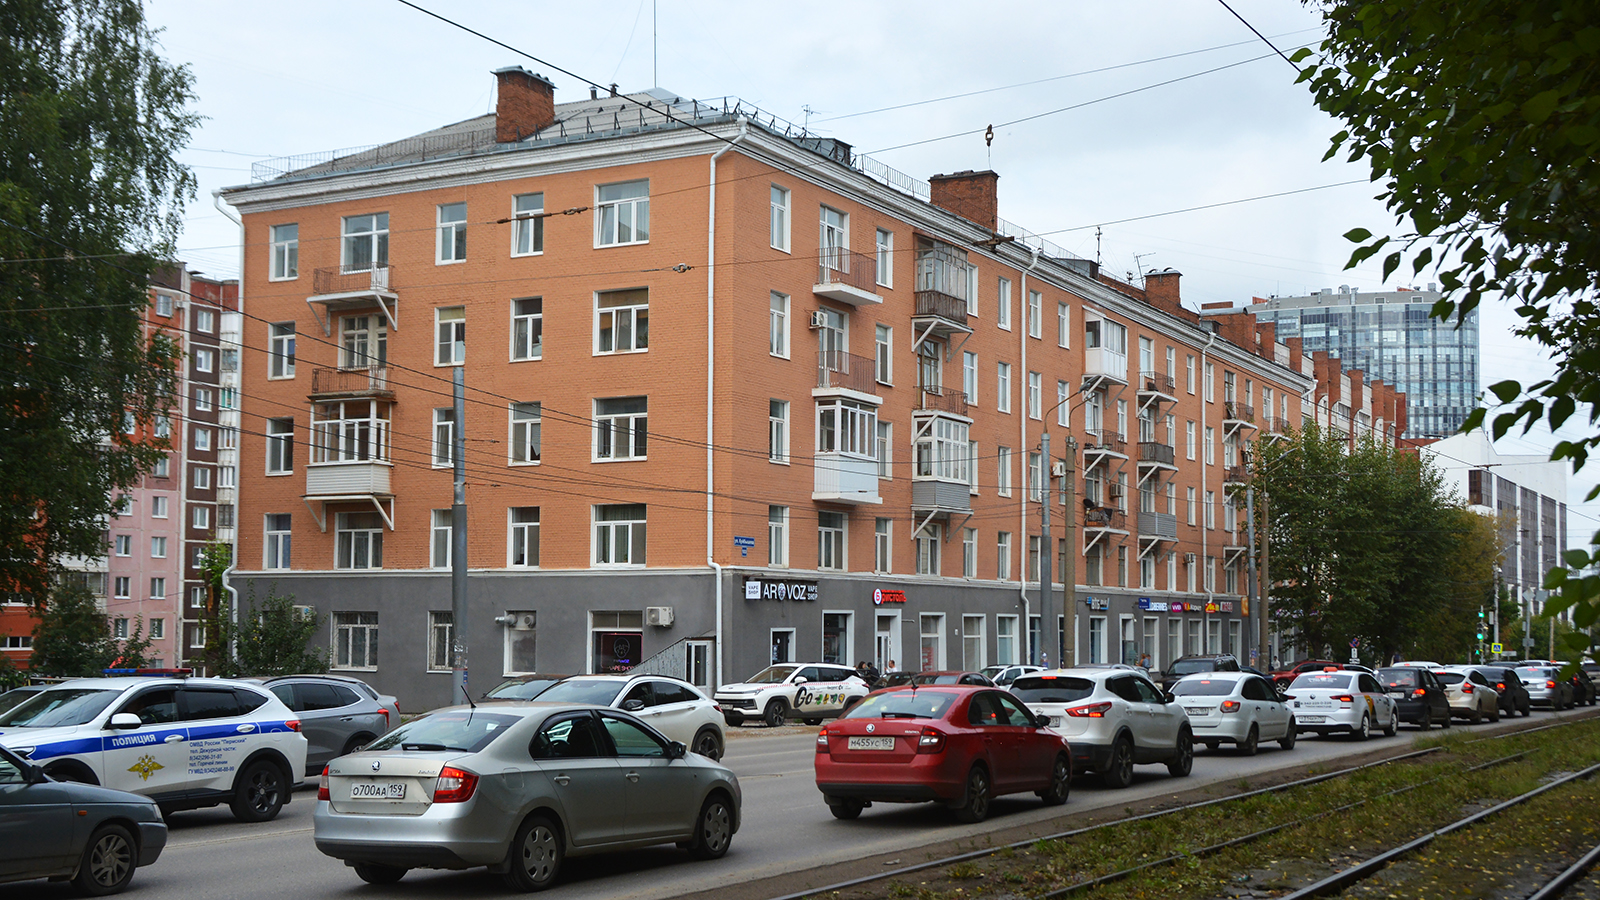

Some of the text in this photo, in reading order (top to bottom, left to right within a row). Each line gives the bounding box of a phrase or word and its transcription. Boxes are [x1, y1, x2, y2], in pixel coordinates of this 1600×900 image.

[794, 686, 813, 708] Go
[112, 734, 156, 747] ПОЛИЦИЯ
[389, 784, 402, 793] 159
